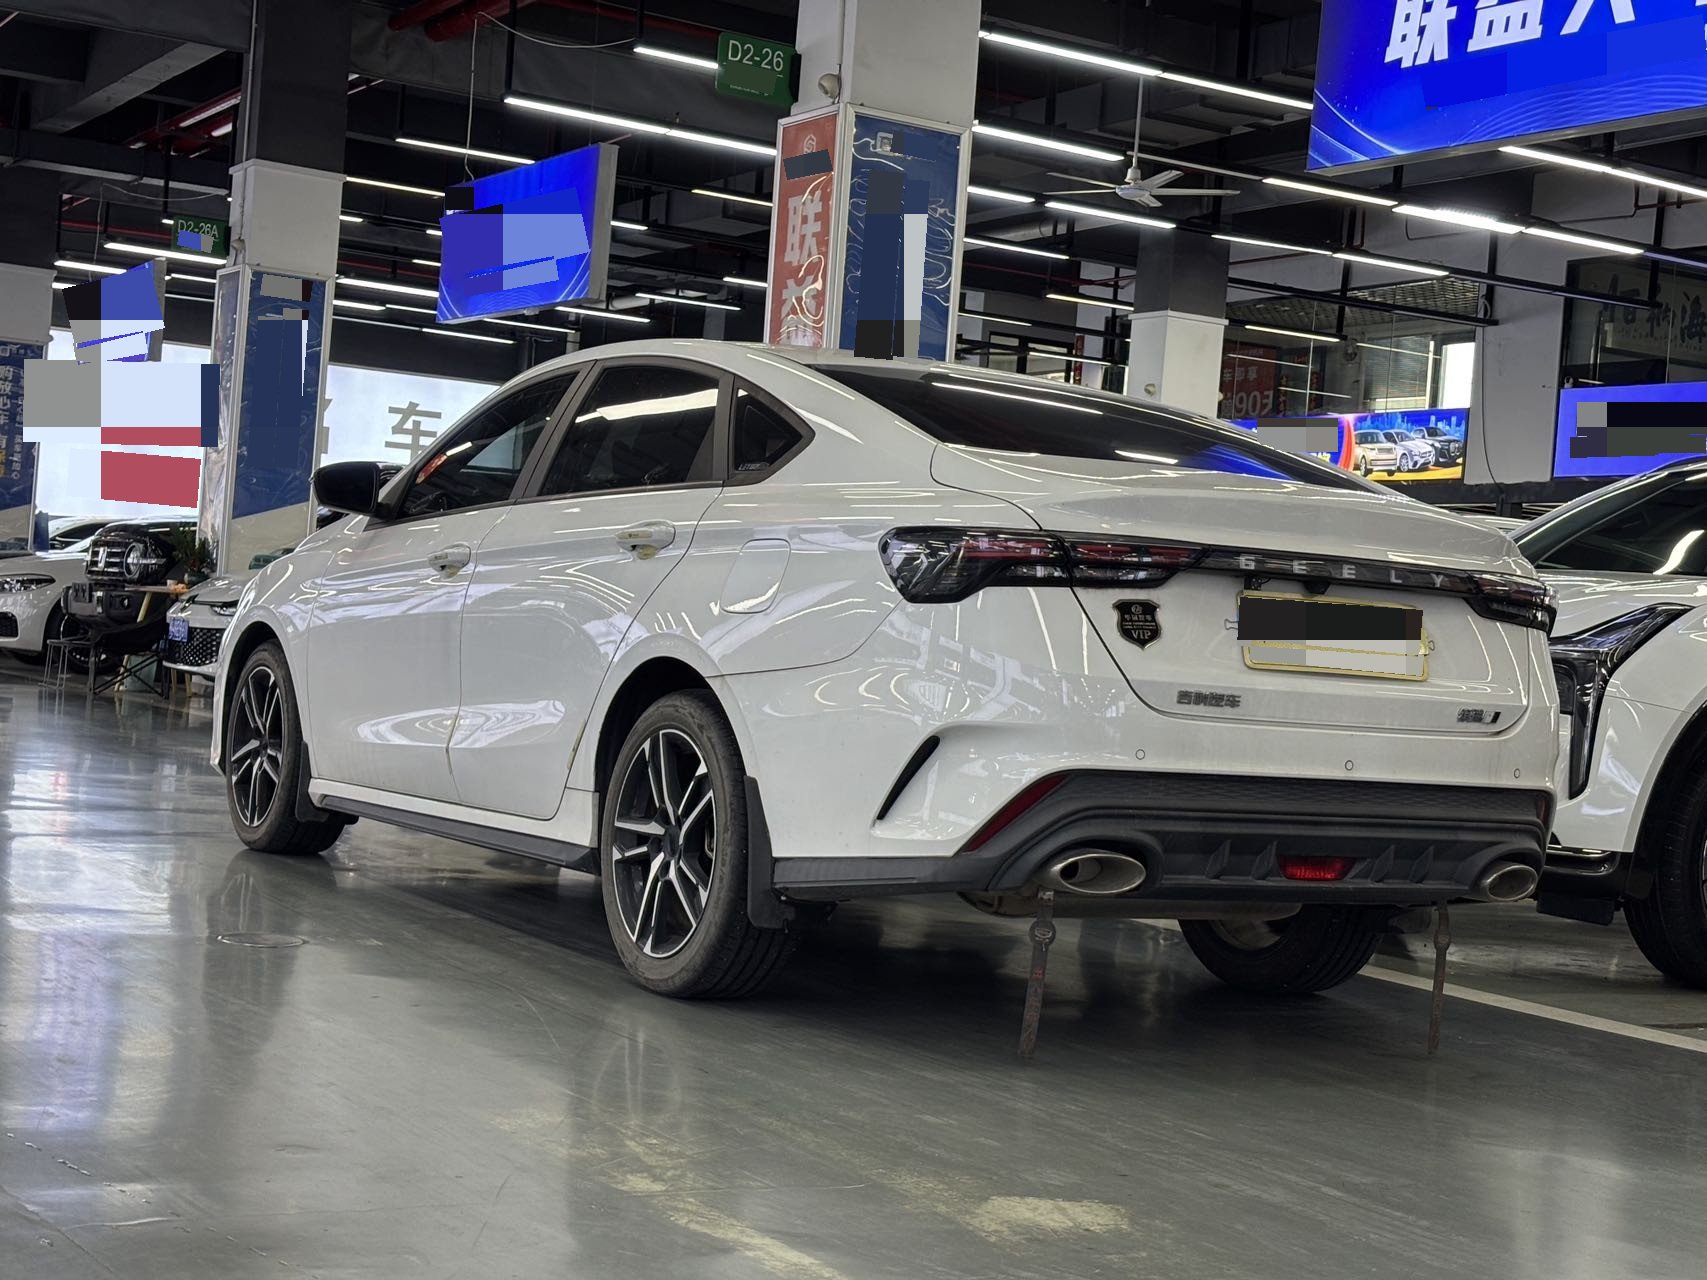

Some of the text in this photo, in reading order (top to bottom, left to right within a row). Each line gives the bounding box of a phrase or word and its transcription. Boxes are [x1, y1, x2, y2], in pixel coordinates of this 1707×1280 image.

[728, 40, 784, 71] D2-26
[178, 220, 219, 238] D2-26A
[1240, 555, 1444, 588] GEELY
[1131, 630, 1151, 639] VIP
[1176, 690, 1242, 708] 吉利汽车
